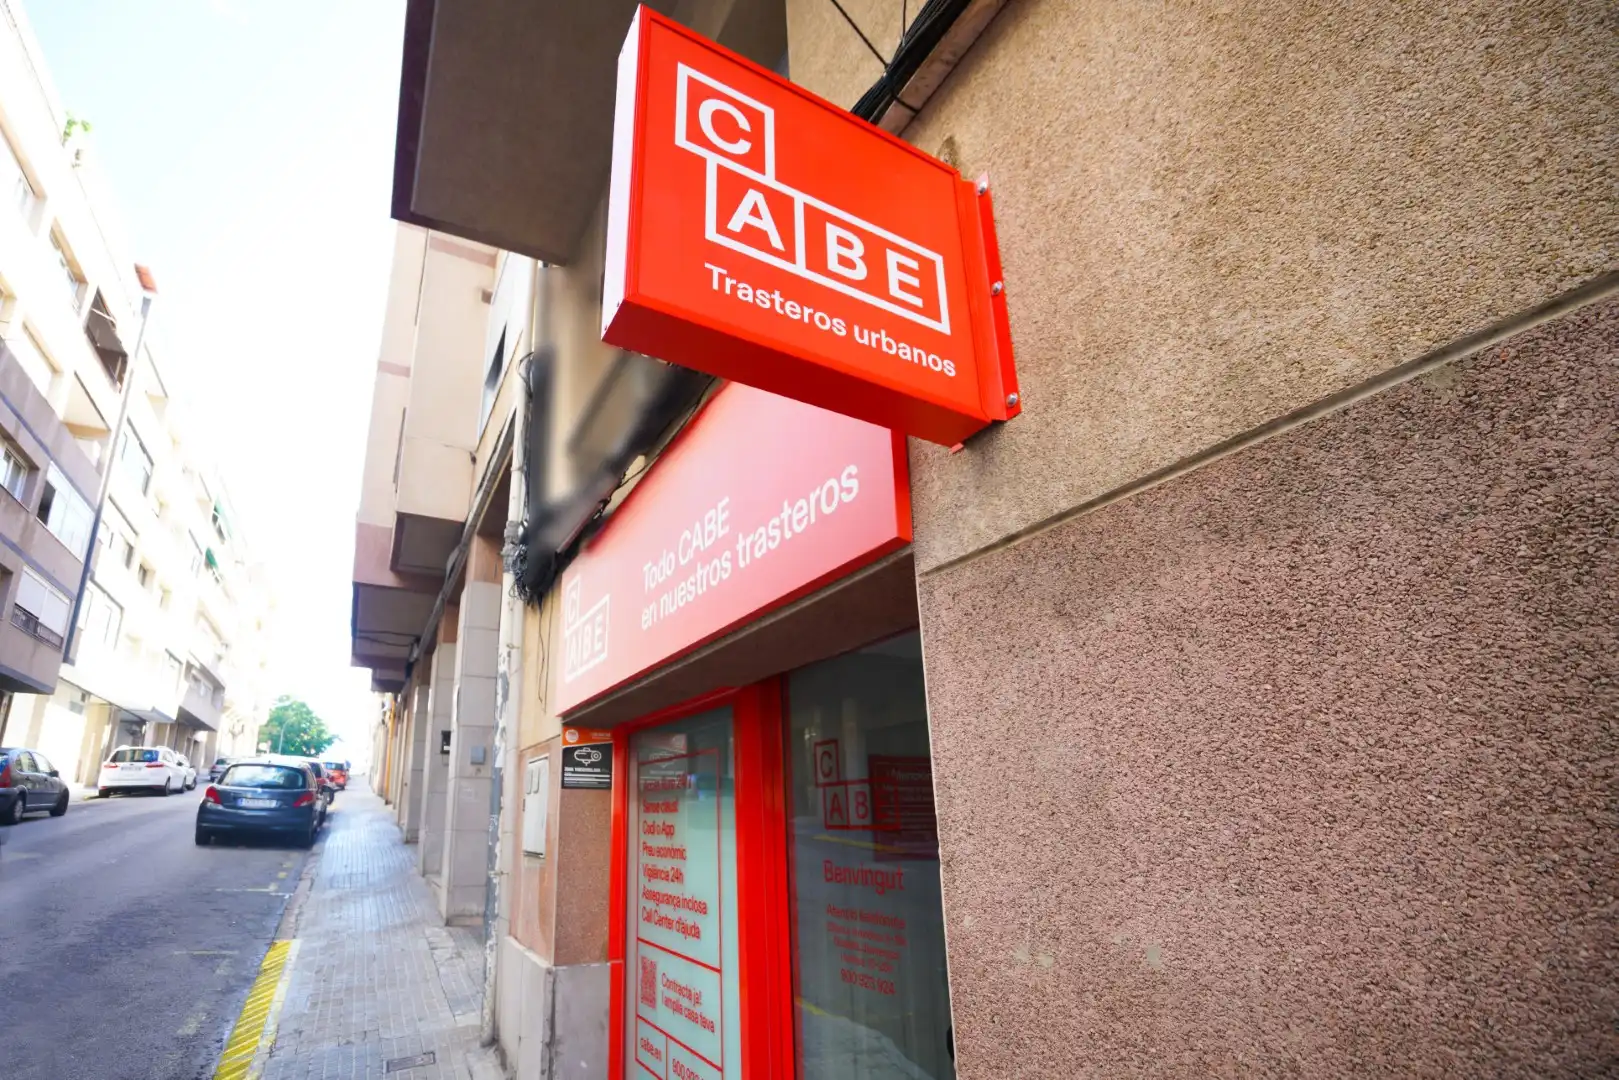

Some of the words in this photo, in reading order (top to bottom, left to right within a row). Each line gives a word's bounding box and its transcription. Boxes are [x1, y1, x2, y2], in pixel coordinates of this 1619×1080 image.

[704, 262, 847, 337] Trasteros
[853, 325, 957, 378] urbanos
[641, 603, 658, 630] en
[660, 550, 732, 616] nuestros
[736, 464, 859, 569] trasteros
[642, 552, 675, 593] Todo
[678, 497, 730, 566] CABE
[662, 821, 675, 840] App
[670, 866, 684, 885] 24h
[823, 860, 905, 895] Benvingut
[682, 894, 708, 915] inclosa
[642, 906, 653, 924] Call
[653, 909, 674, 930] Center
[840, 967, 857, 985] 900
